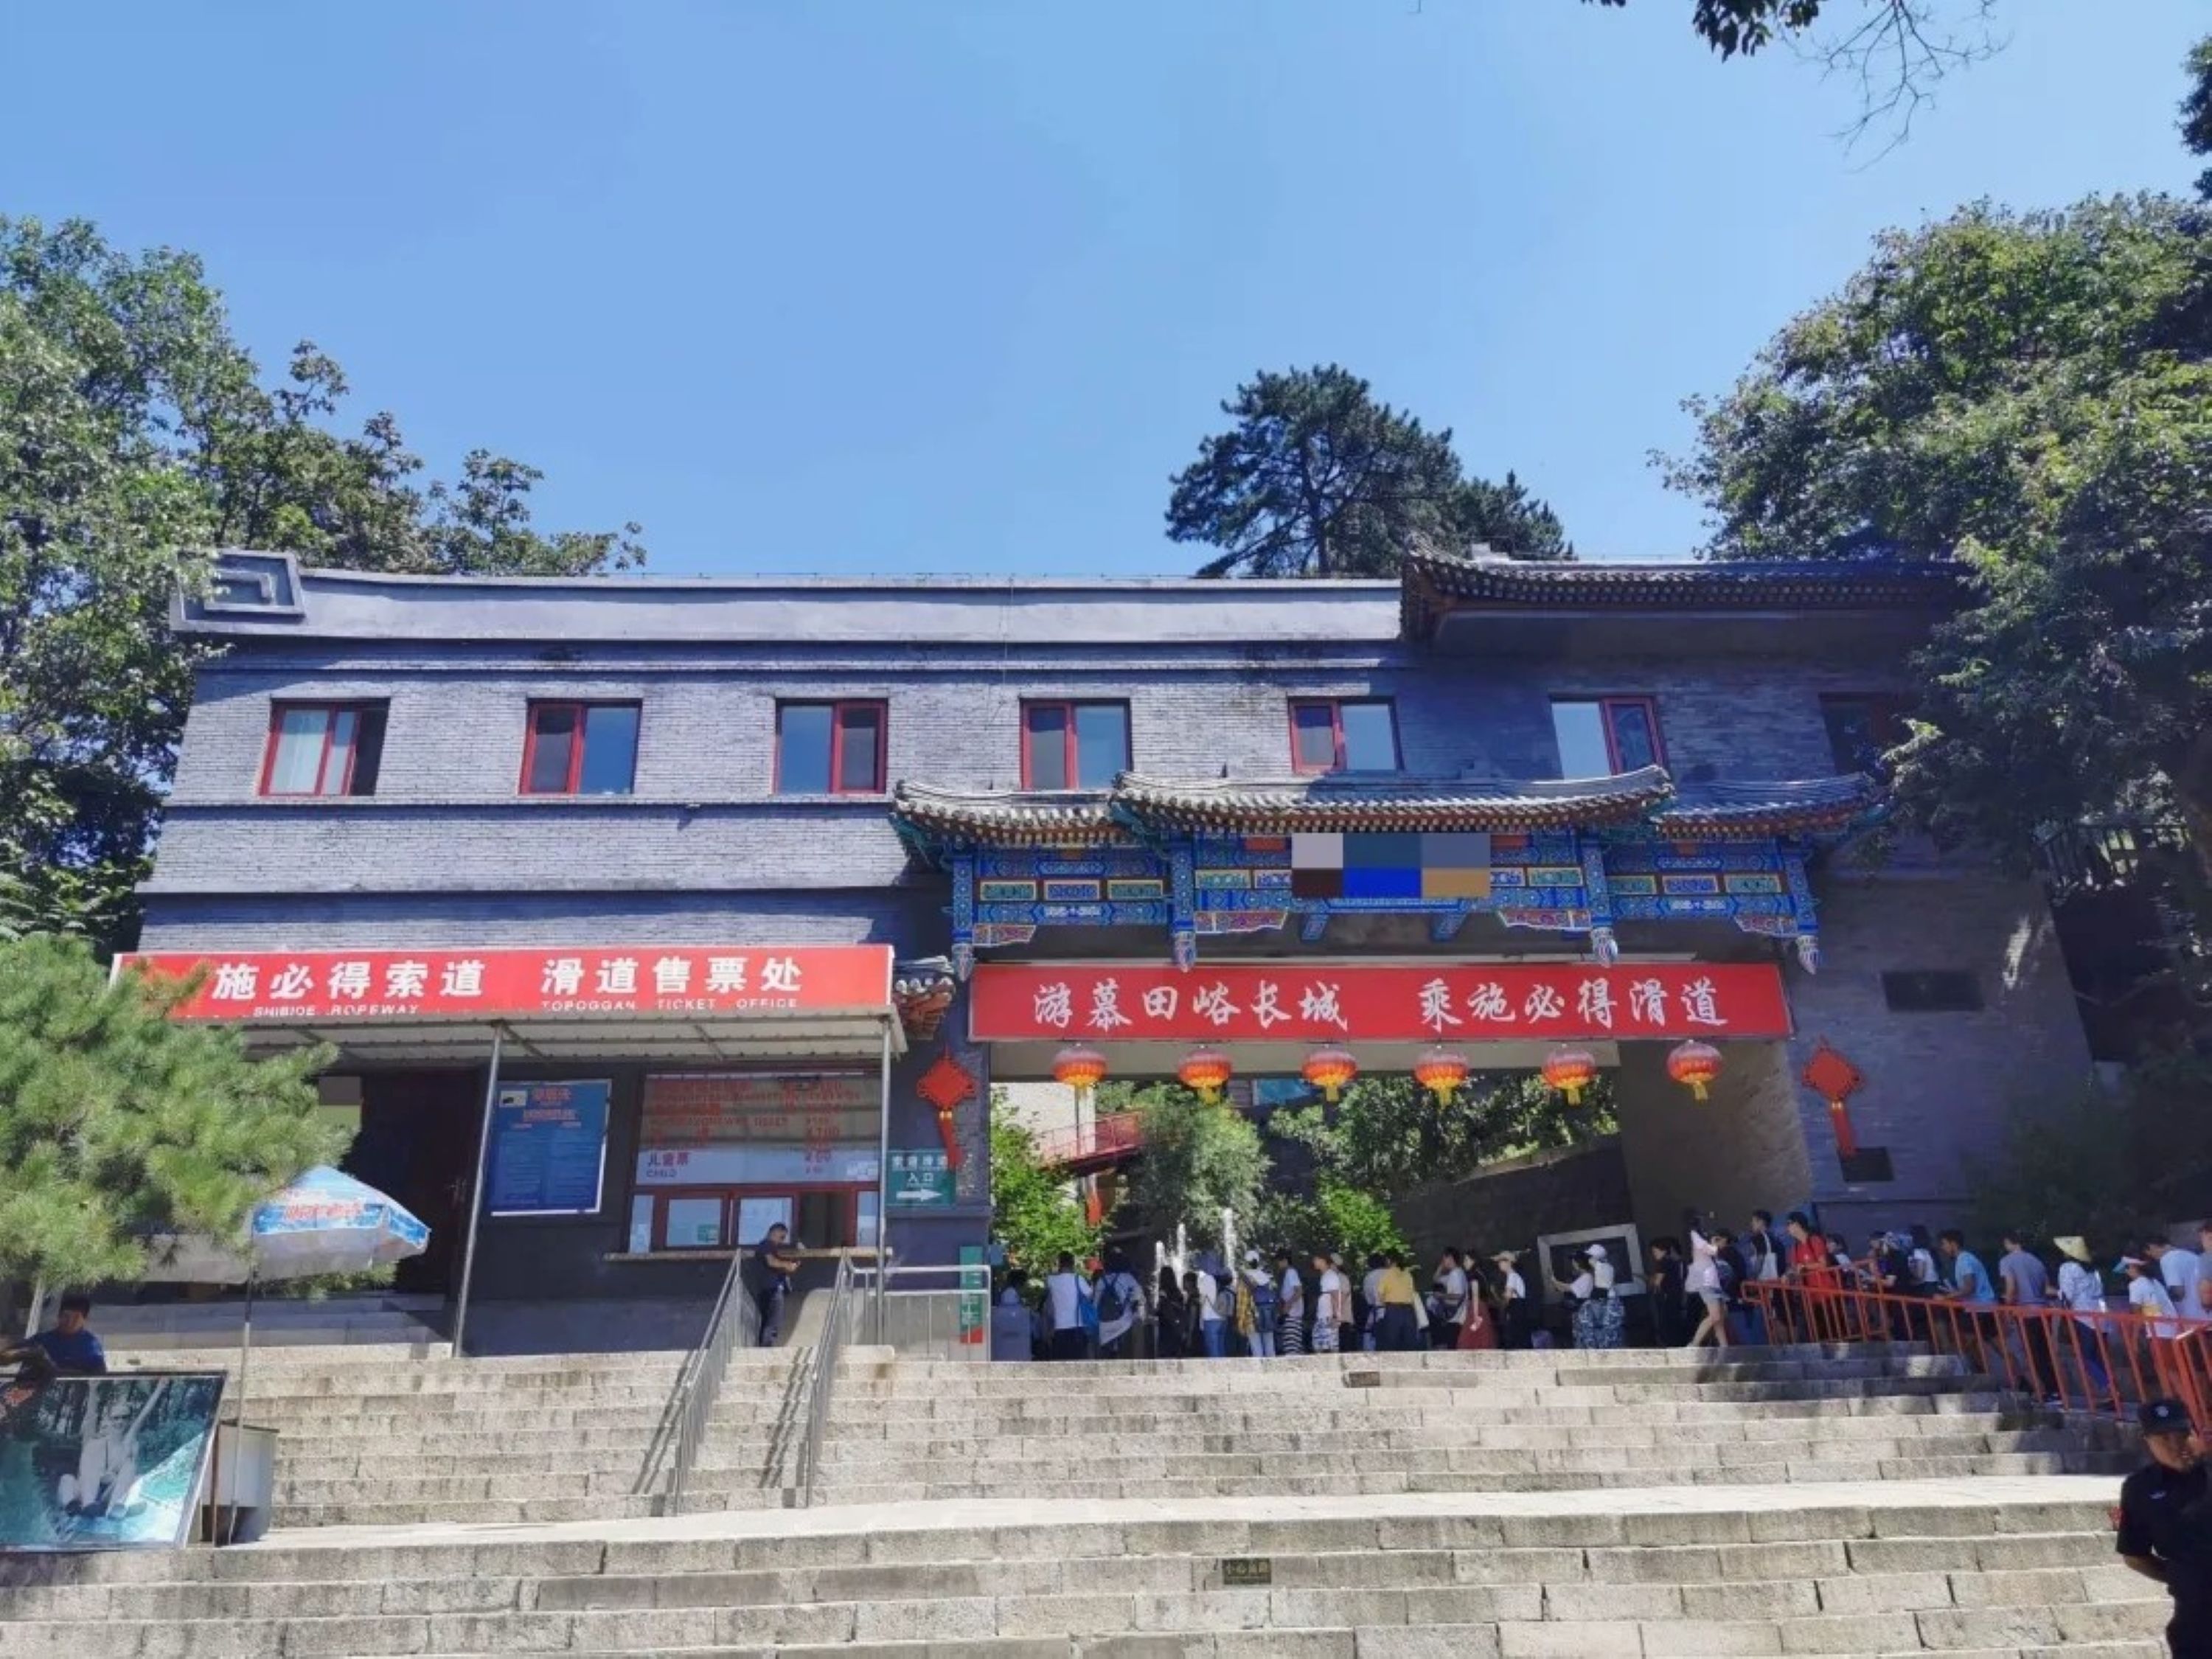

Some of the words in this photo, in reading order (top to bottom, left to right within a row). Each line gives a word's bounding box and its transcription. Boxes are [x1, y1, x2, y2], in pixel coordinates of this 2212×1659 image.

[212, 959, 485, 1001] 施必得索道
[542, 956, 801, 995] 滑道售票处
[657, 998, 716, 1010] TICKET
[1034, 978, 1348, 1032] 游慕田峪长城
[1419, 977, 1728, 1032] 乘施必得滑道
